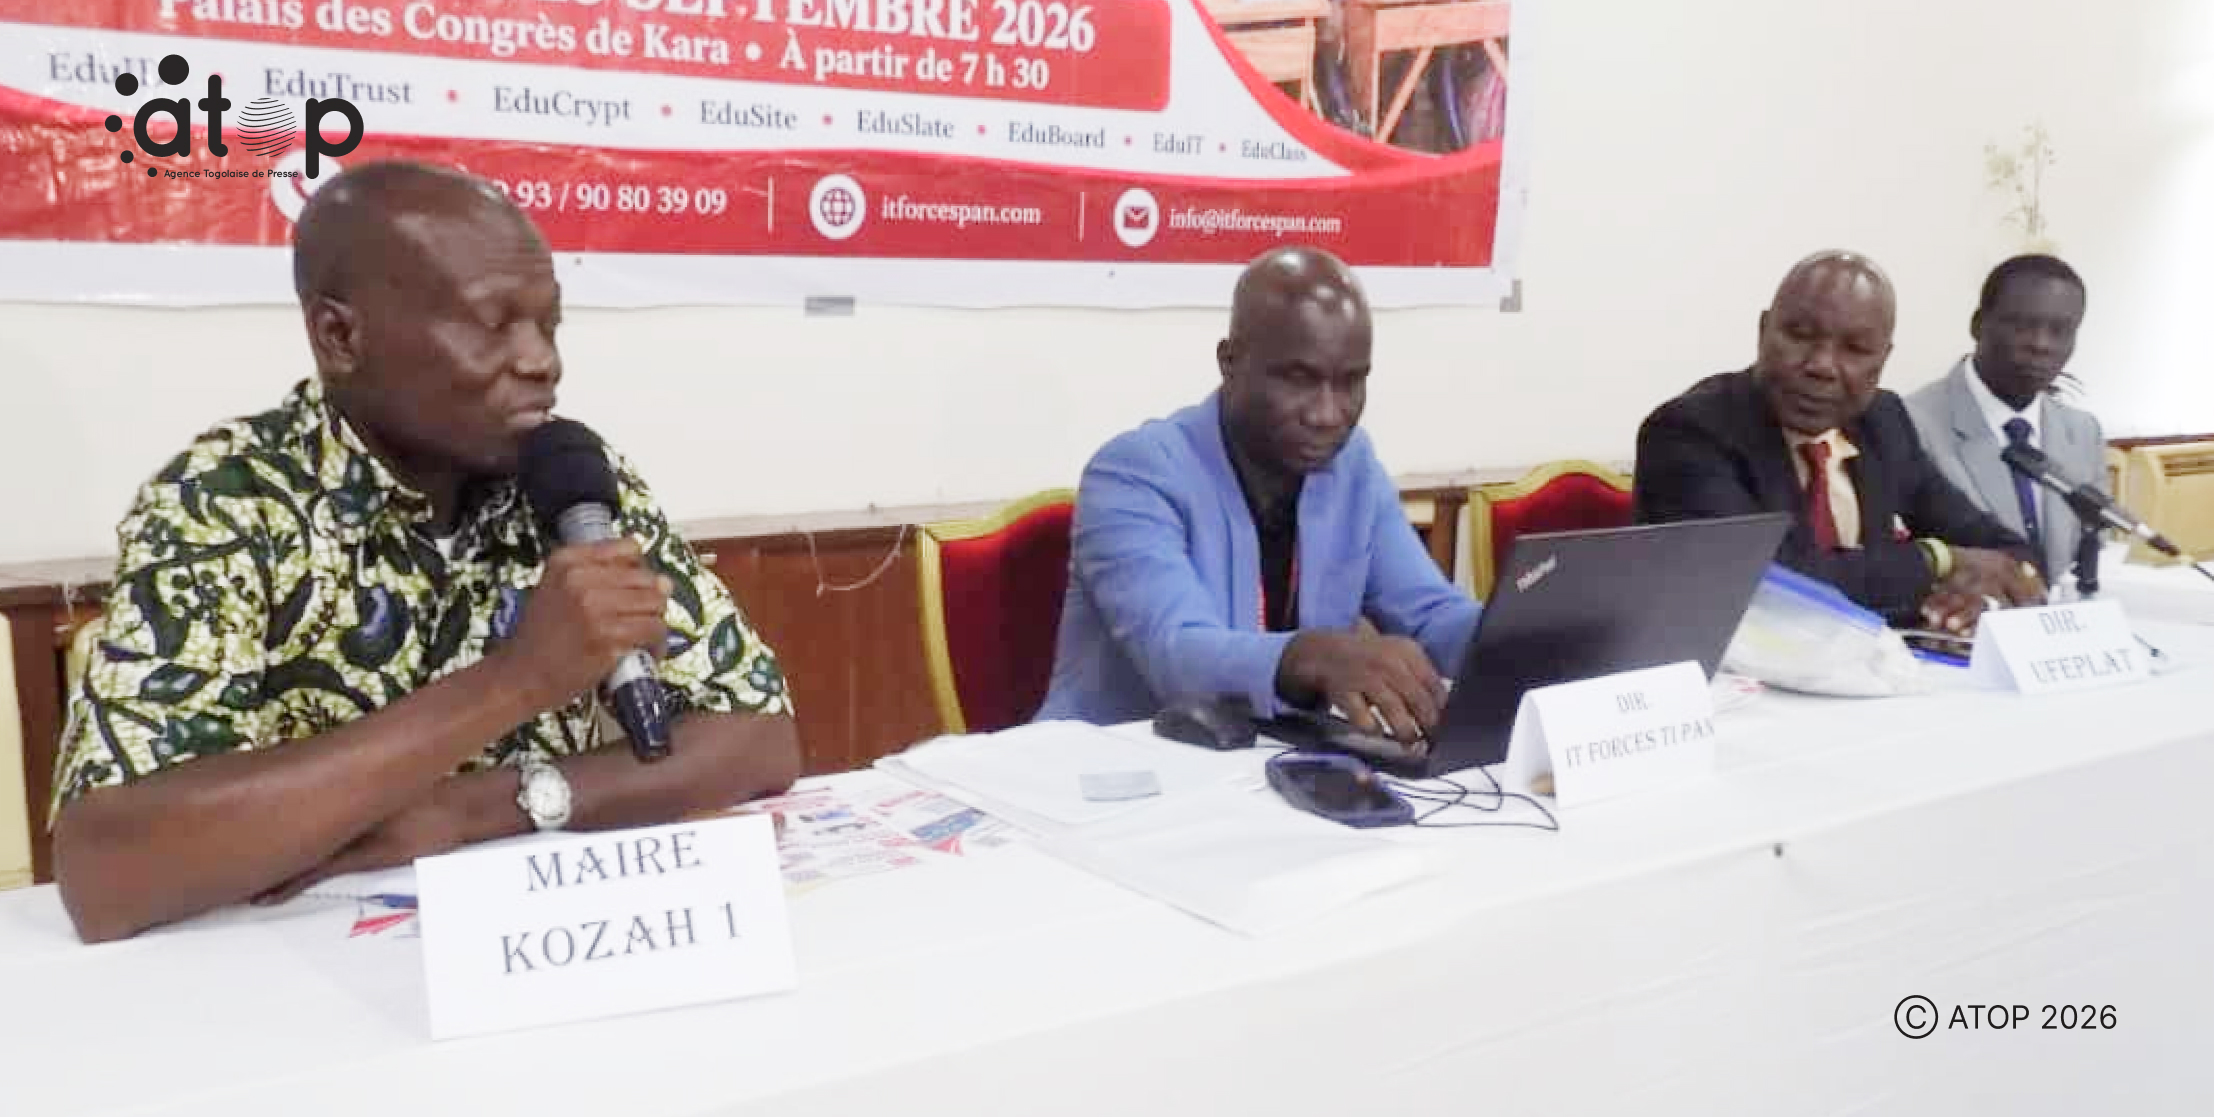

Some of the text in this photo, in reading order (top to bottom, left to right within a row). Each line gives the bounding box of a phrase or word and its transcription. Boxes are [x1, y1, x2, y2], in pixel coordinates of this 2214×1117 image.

[315, 0, 391, 36] des
[403, 2, 577, 57] Congrès
[585, 17, 634, 55] de
[642, 23, 729, 65] Kara
[780, 26, 807, 71] À
[814, 45, 908, 81] partir
[916, 48, 953, 82] de
[960, 52, 980, 84] 7
[986, 52, 1006, 86] h
[1012, 57, 1050, 90] 30
[991, 0, 1097, 53] 2026
[264, 68, 414, 105] EduTrust
[493, 85, 632, 127] EduCrypt
[700, 101, 798, 131] EduSite
[856, 110, 955, 139] EduSlate
[1008, 121, 1106, 148] EduBoard
[1153, 133, 1203, 155] EduIT
[517, 180, 552, 208] 93
[576, 183, 611, 212] 90
[617, 184, 650, 212] 80
[657, 186, 688, 214] 39
[694, 187, 727, 215] 09
[881, 195, 1042, 226] itforcespan.com
[1566, 744, 1582, 768] IT
[1589, 730, 1657, 762] FORCES
[525, 830, 704, 891] MAIRE
[500, 907, 696, 974] KOZAH
